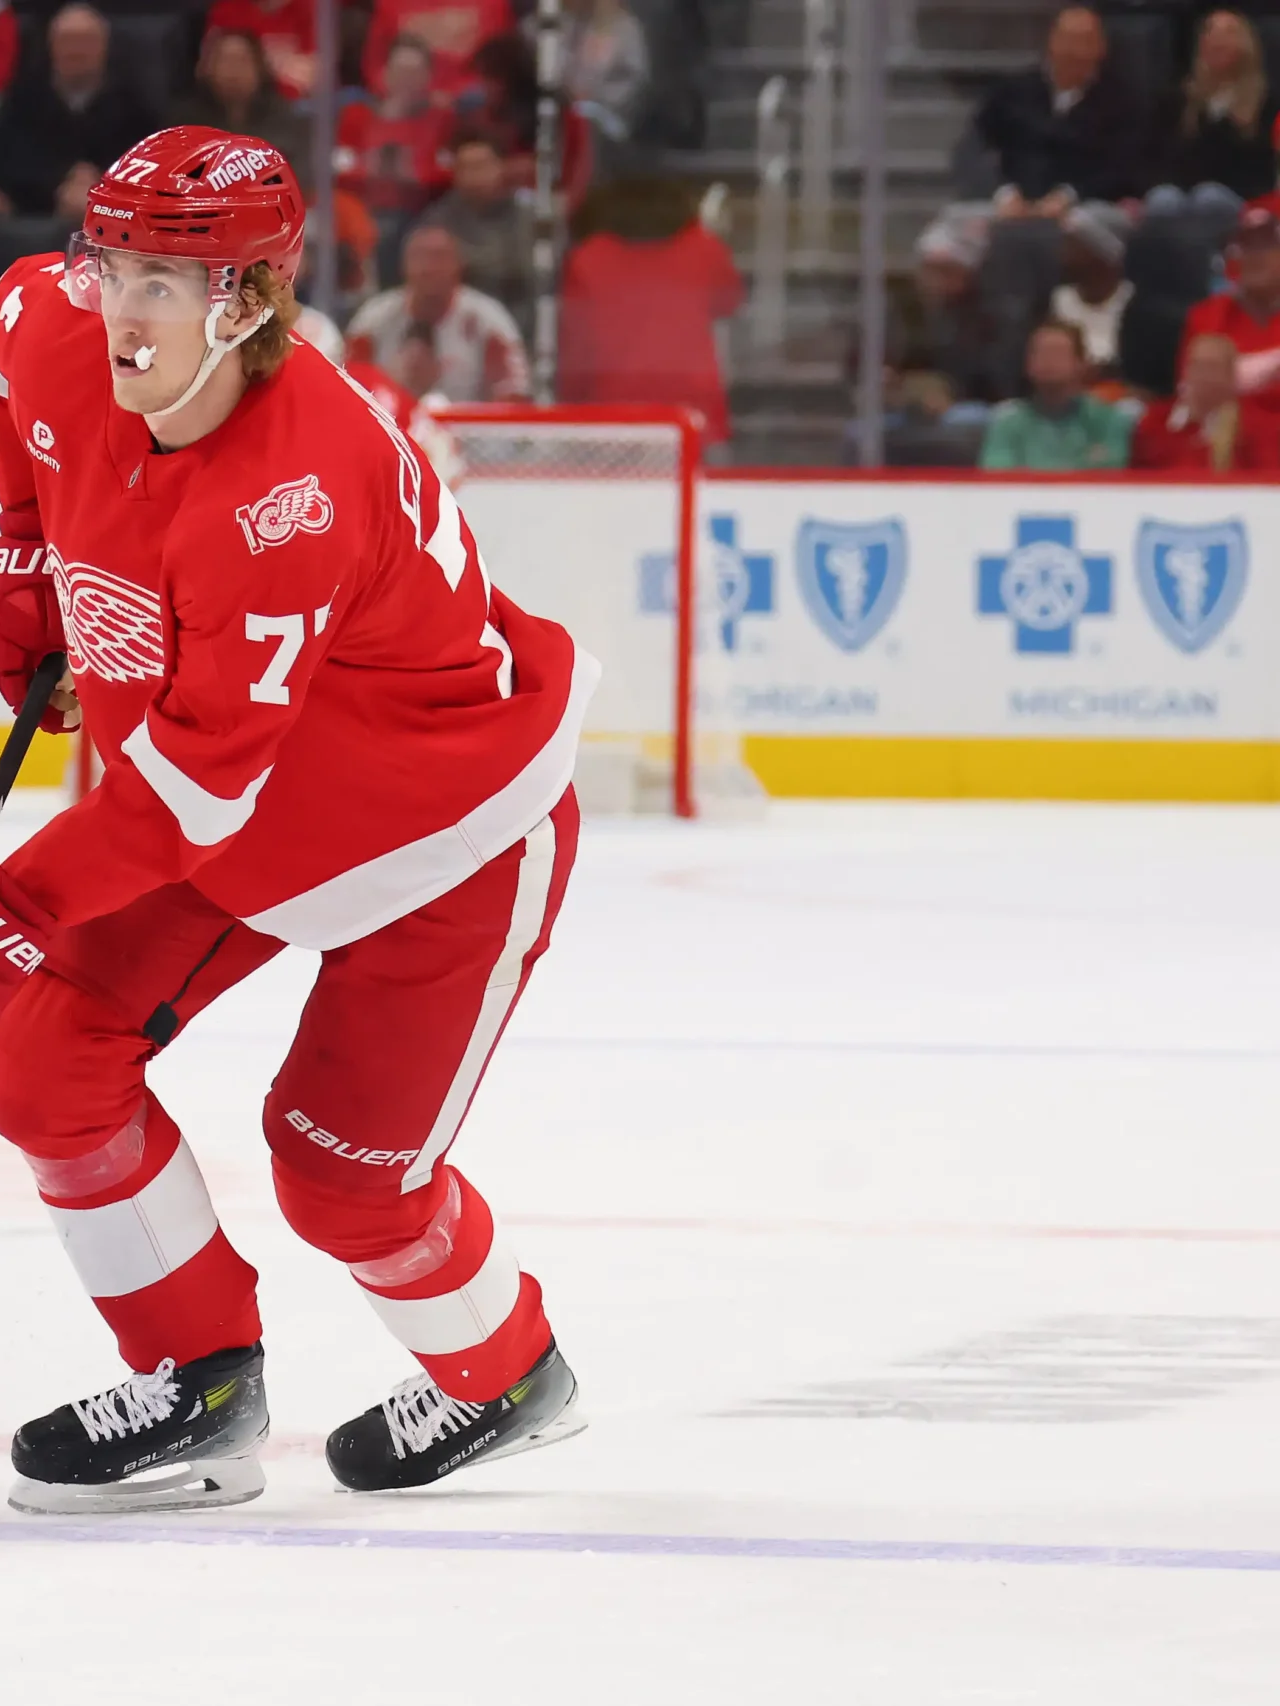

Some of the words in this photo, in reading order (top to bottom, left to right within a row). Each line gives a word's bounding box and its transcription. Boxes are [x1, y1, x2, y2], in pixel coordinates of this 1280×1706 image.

[114, 158, 160, 184] 77
[206, 149, 269, 192] meijer
[93, 204, 134, 220] BAUER
[245, 597, 333, 706] 7
[283, 1109, 420, 1166] BAUER
[437, 1428, 498, 1475] BAUER
